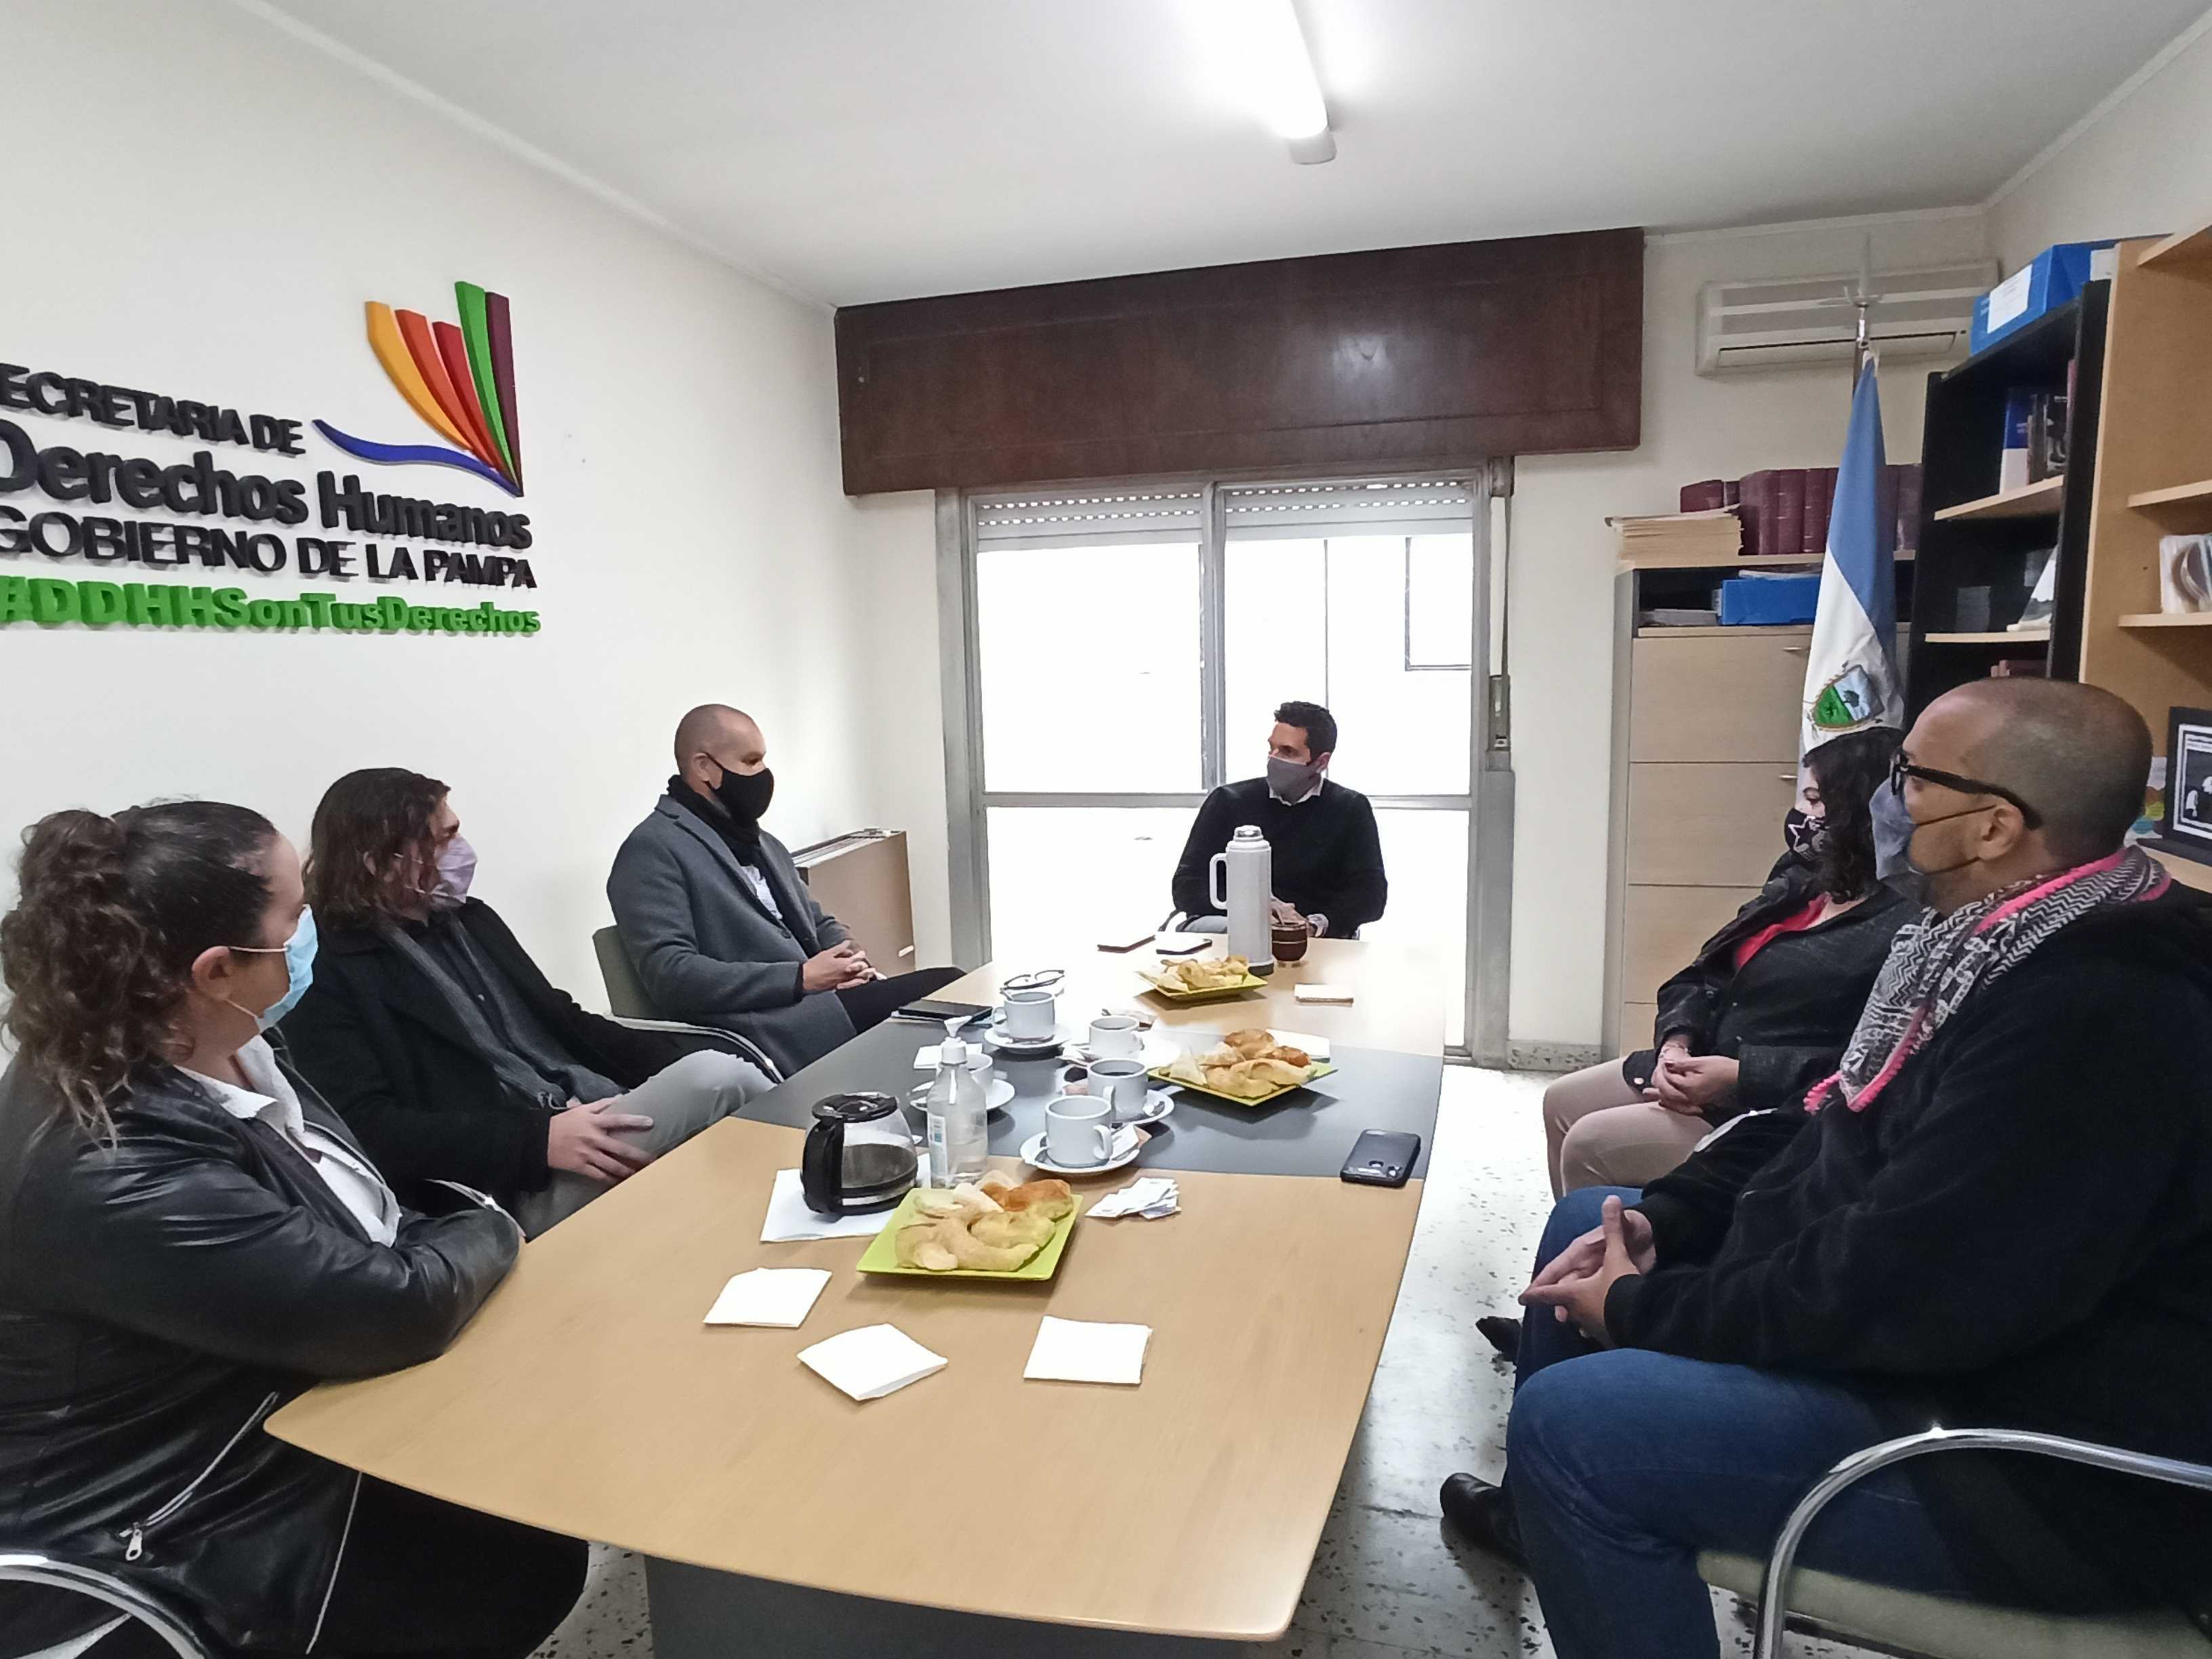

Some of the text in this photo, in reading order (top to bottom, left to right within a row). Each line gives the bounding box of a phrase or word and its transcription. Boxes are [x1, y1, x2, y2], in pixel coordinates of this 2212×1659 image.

[249, 414, 306, 455] DE
[0, 419, 533, 550] Derechos Humanos
[0, 506, 537, 588] GOBIERNO DE LA PAMPA
